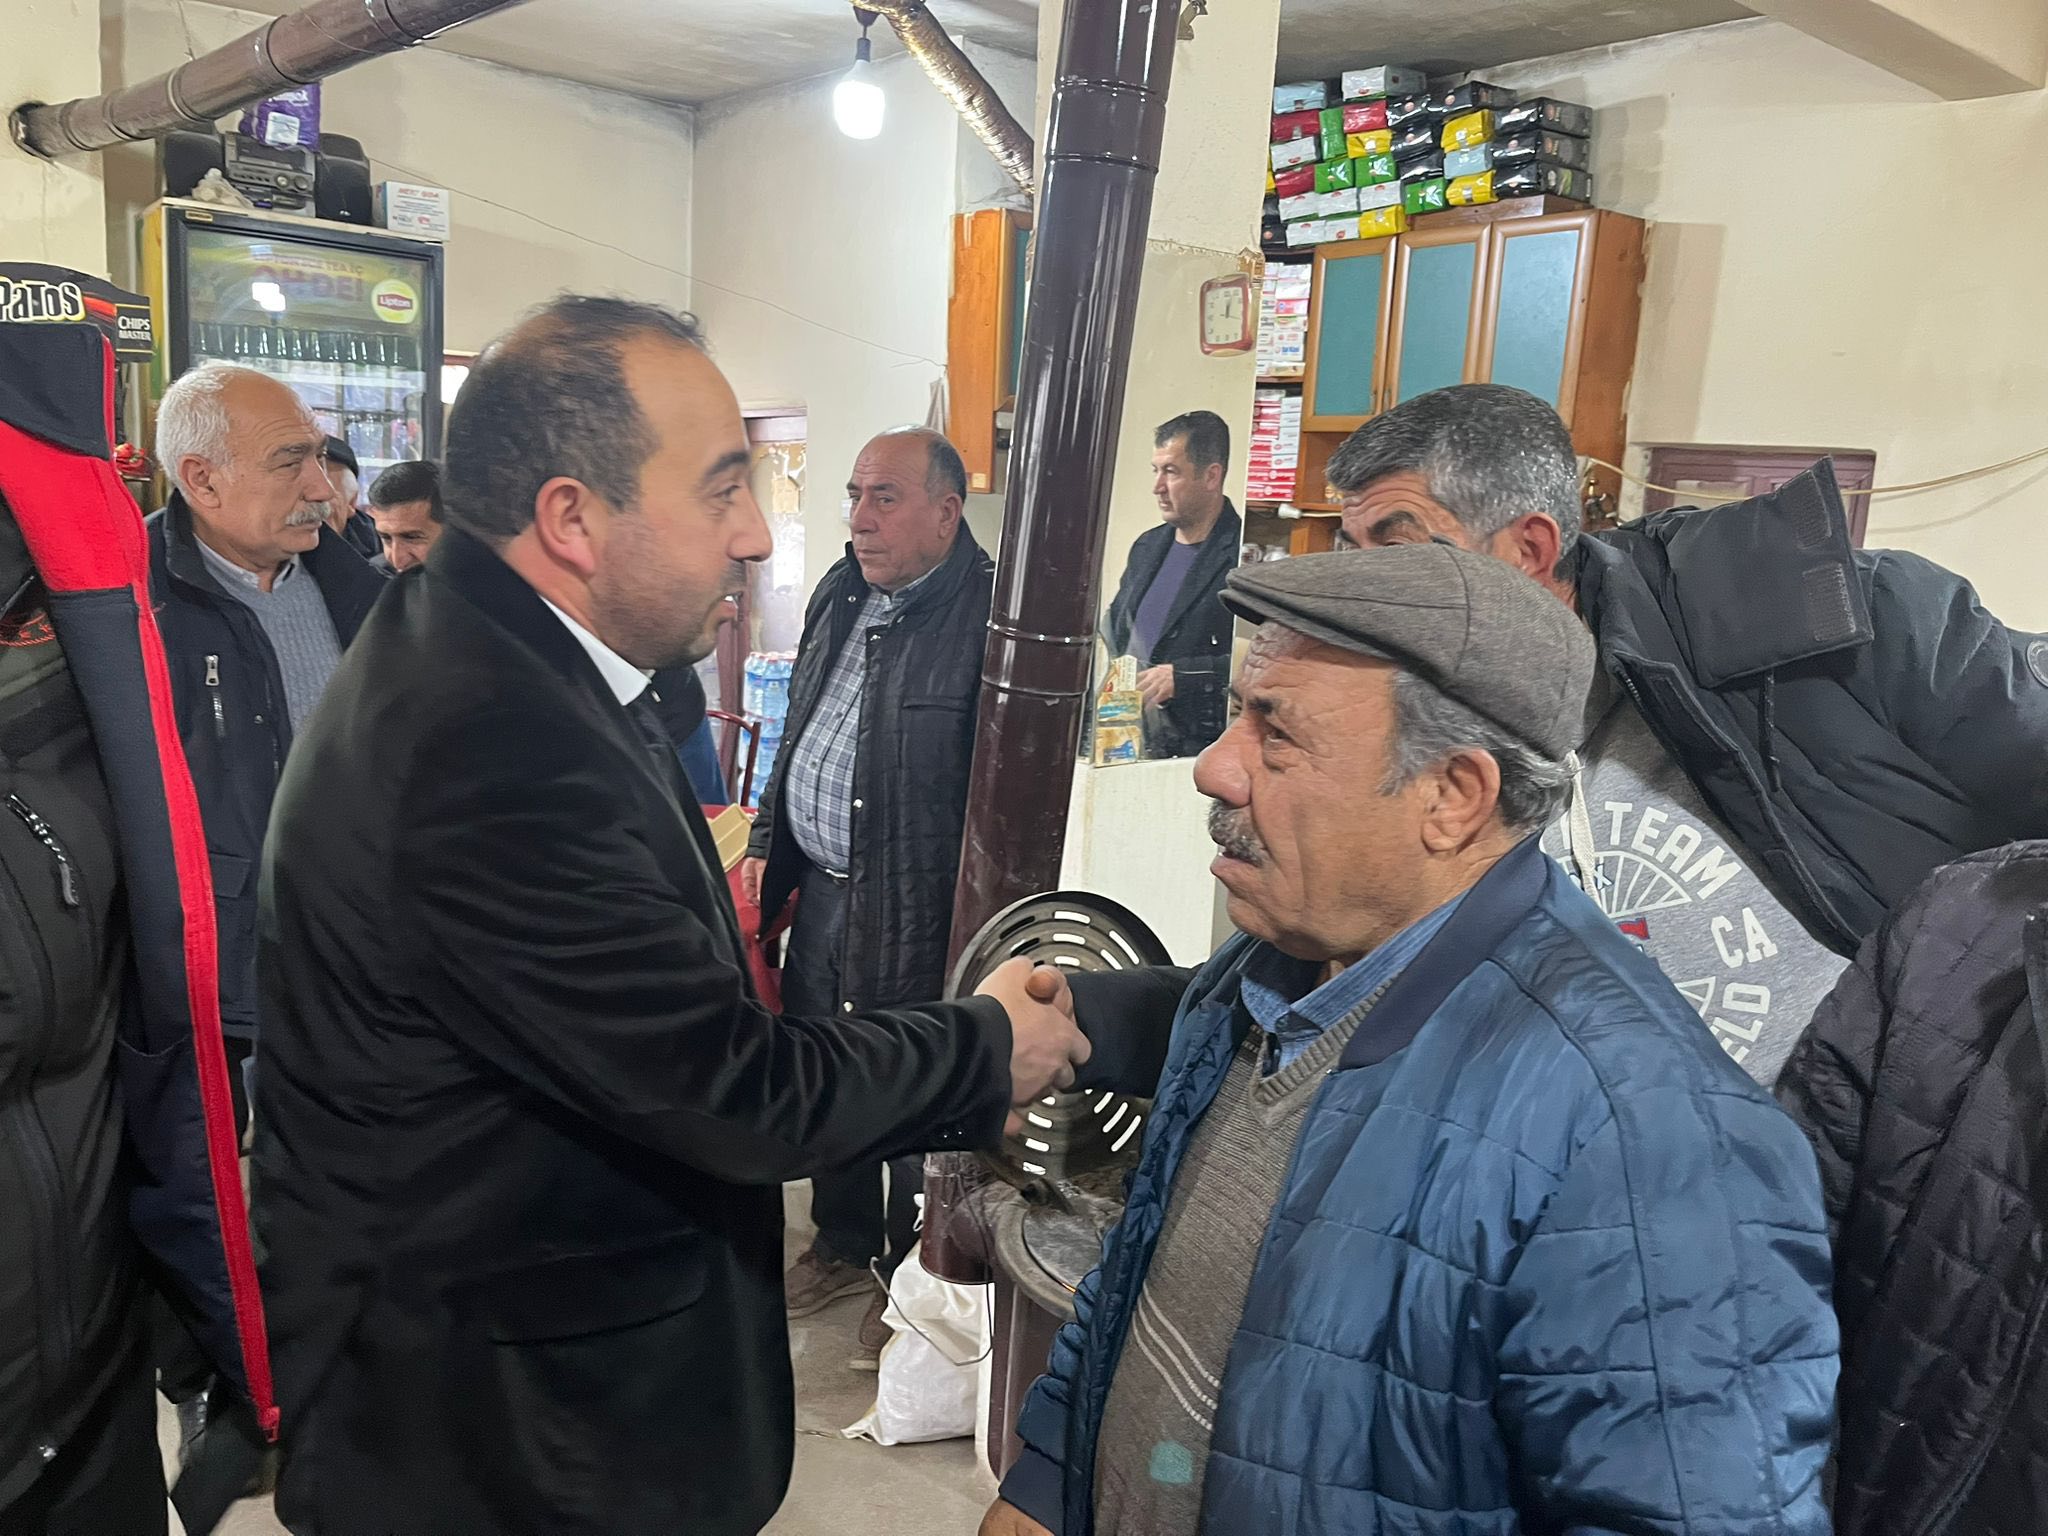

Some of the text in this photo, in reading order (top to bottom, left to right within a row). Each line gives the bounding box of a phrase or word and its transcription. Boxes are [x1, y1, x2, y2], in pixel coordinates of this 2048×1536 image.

[379, 295, 411, 308] Lipton
[118, 315, 151, 331] CHIPS
[119, 329, 152, 342] MASTER
[1604, 801, 1742, 900] TEAM
[1710, 907, 1779, 968] CA
